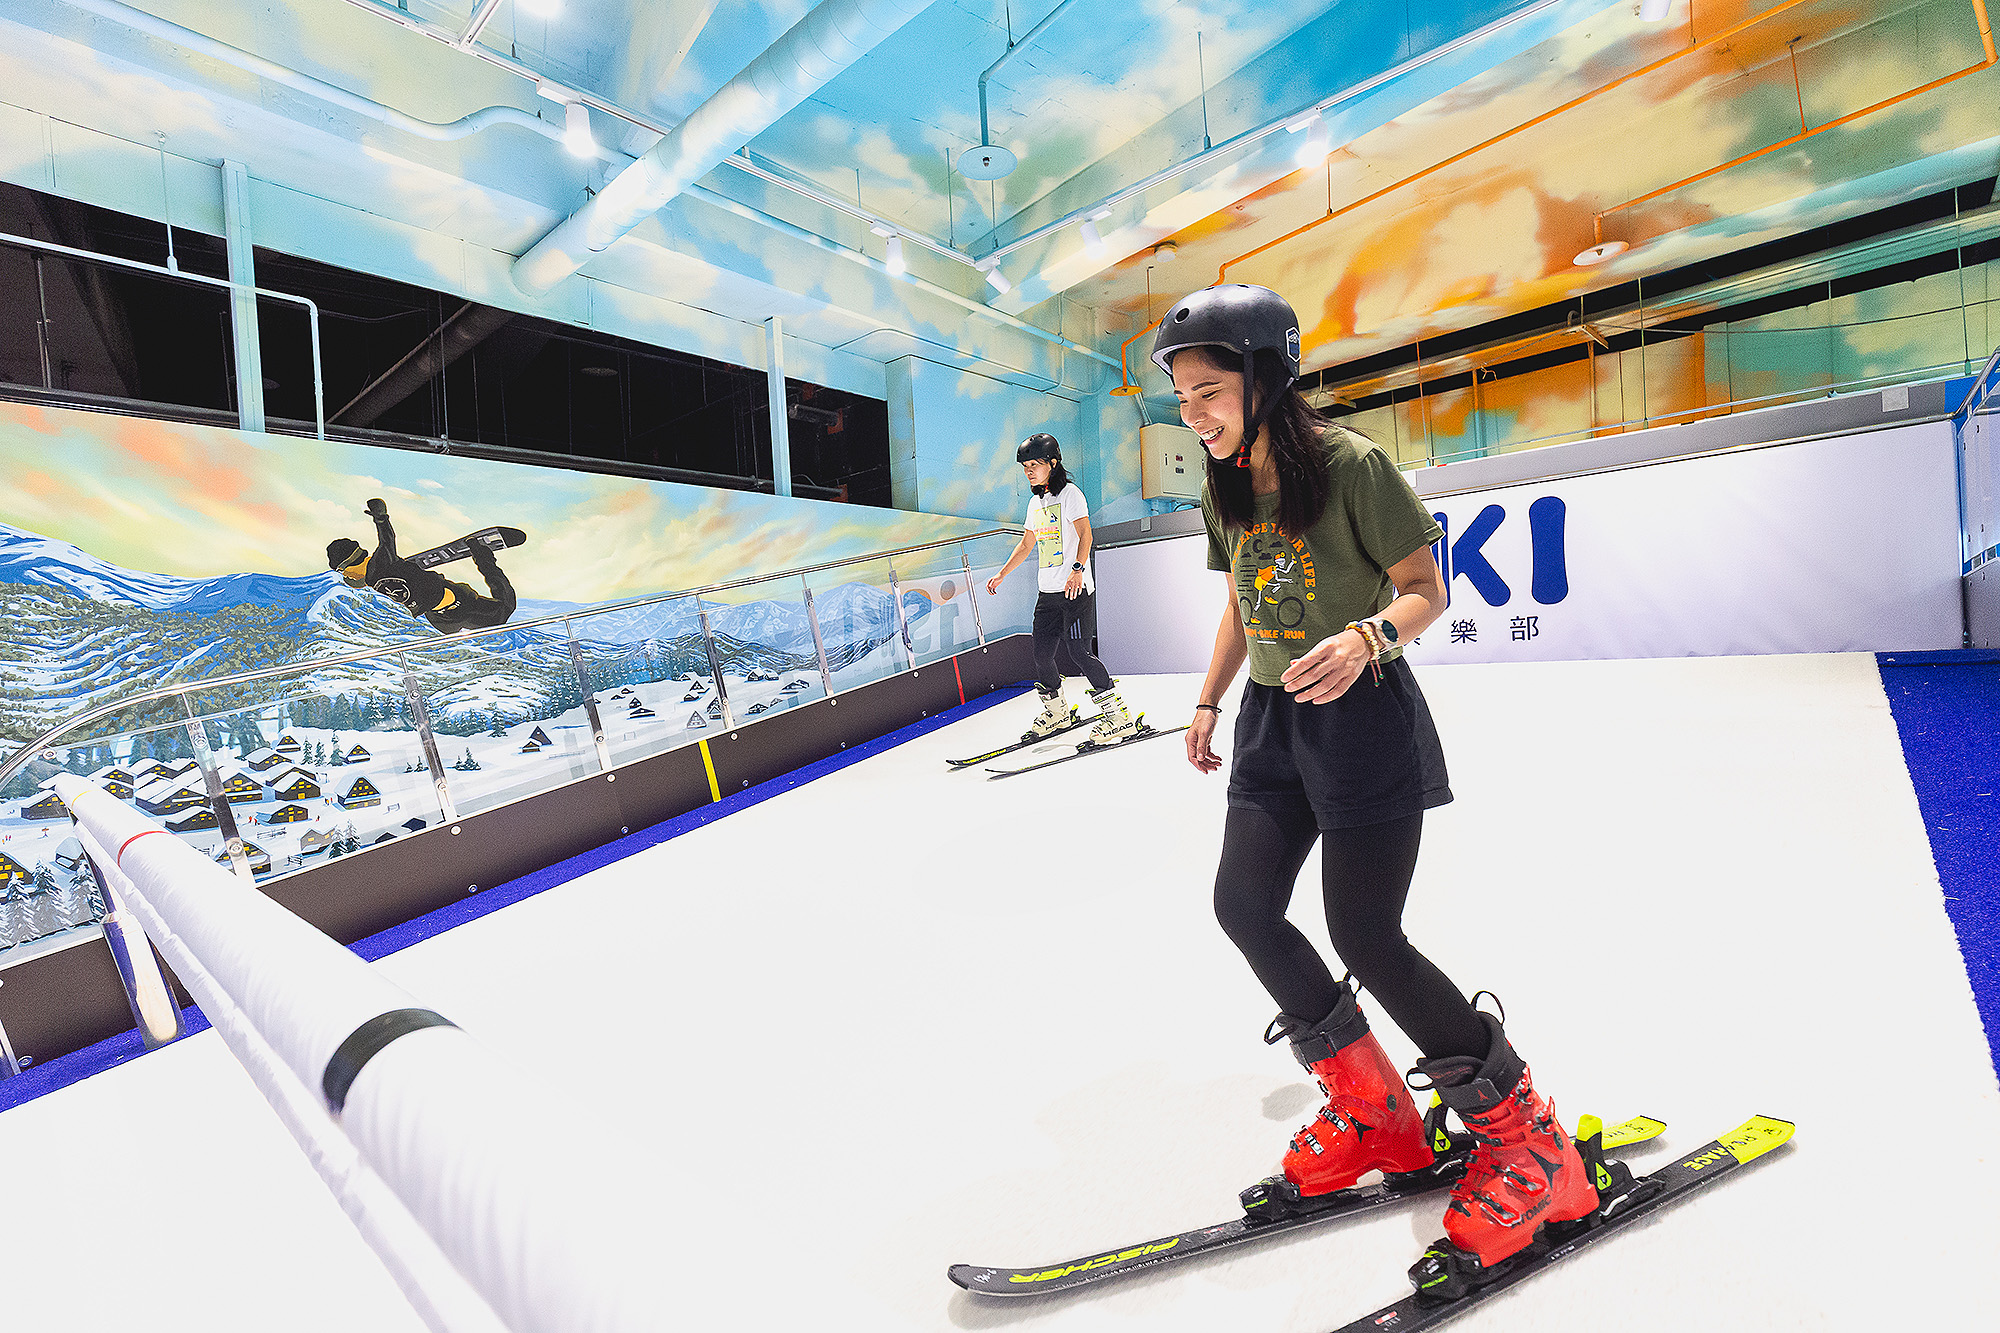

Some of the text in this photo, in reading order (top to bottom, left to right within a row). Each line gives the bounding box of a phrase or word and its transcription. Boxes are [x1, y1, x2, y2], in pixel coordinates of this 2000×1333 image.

[1430, 496, 1569, 610] KI
[1299, 551, 1316, 589] LIFE
[1283, 629, 1306, 640] RUN
[1404, 615, 1539, 647] 樂部
[1103, 721, 1134, 738] HEAD
[1682, 1146, 1729, 1171] RACE
[1008, 1237, 1180, 1284] FISCHER
